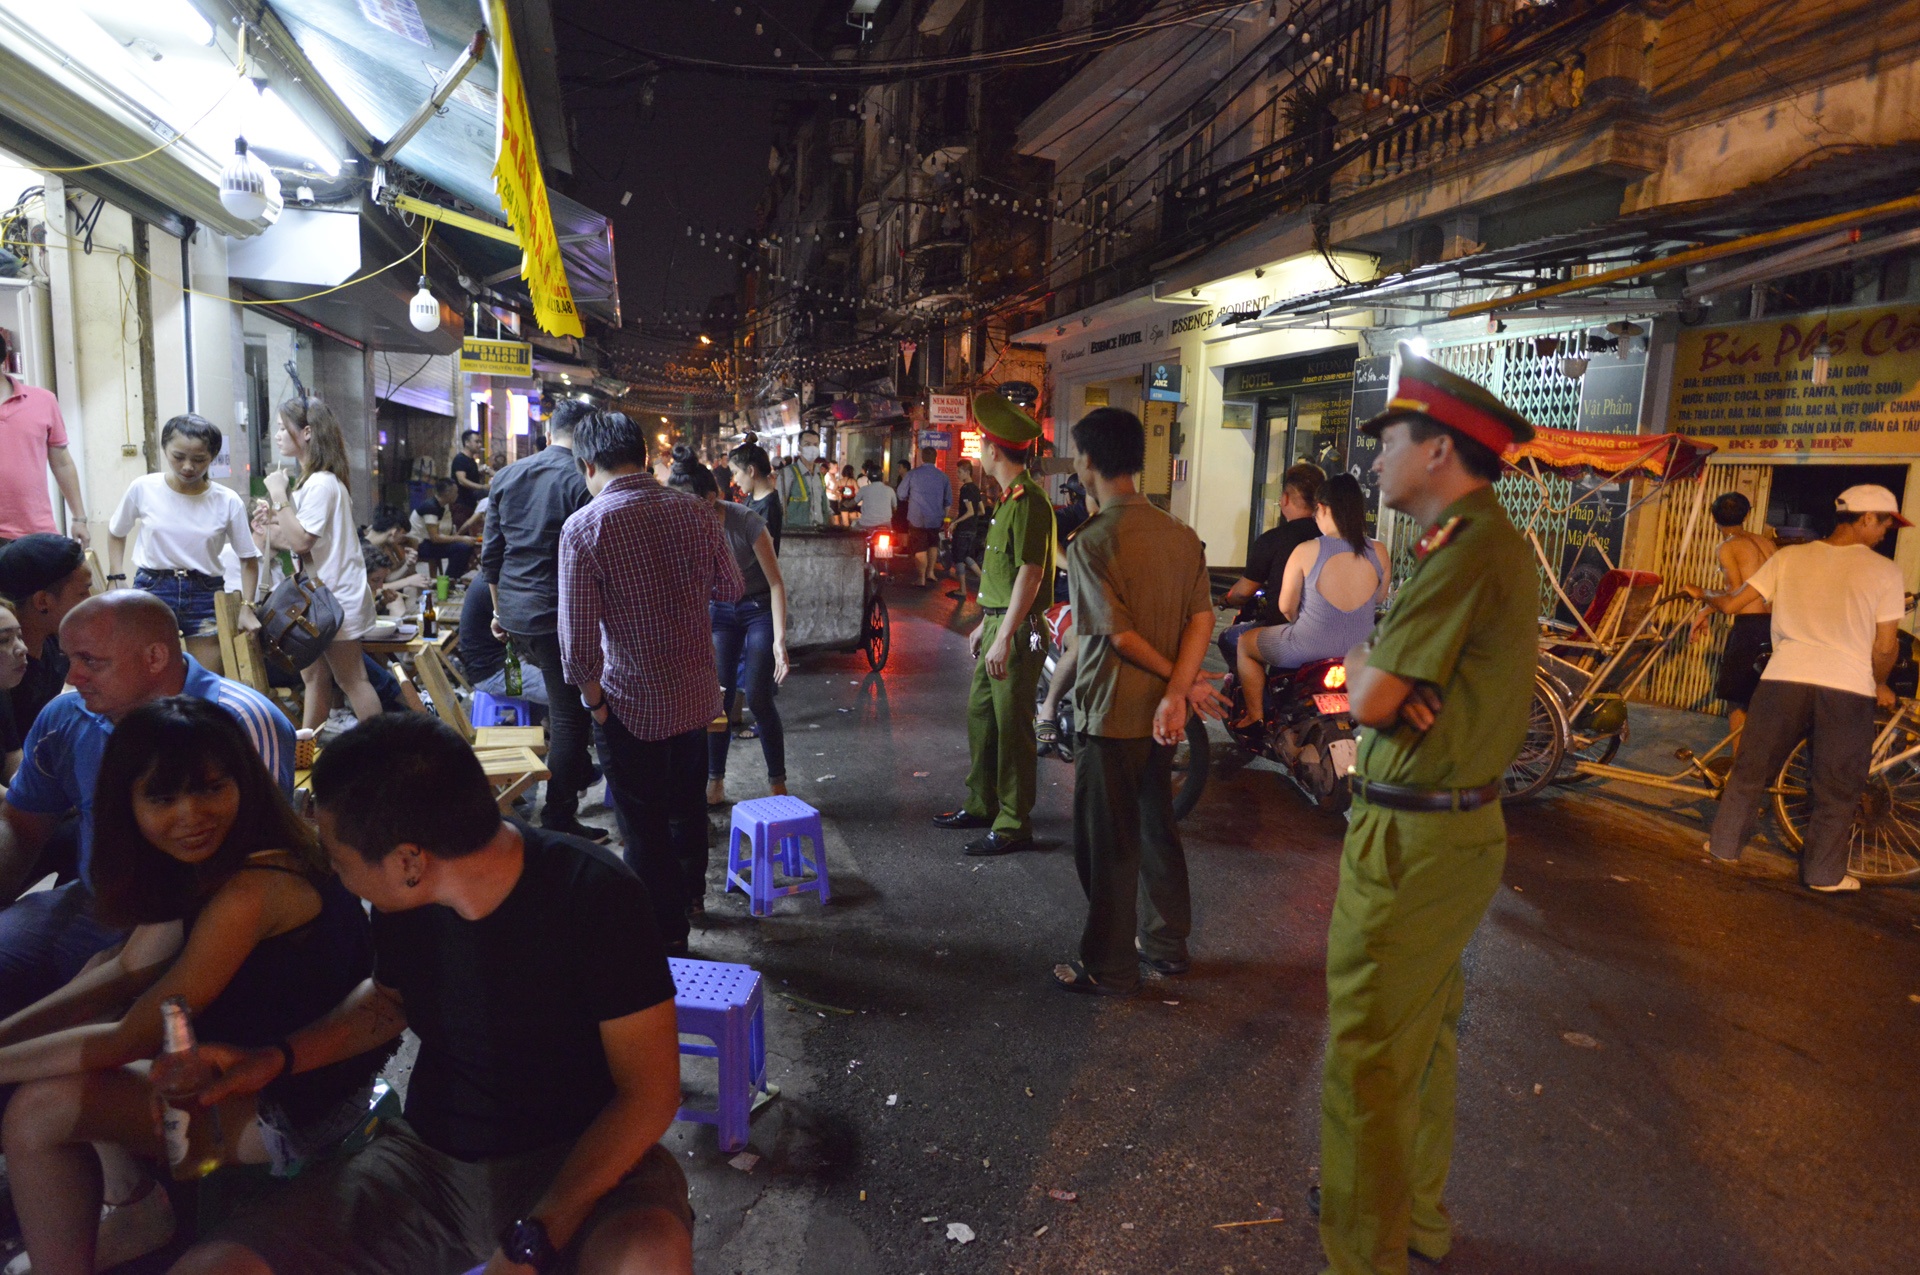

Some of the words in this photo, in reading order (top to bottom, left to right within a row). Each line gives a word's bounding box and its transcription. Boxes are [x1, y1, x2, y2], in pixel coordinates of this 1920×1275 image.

[1171, 310, 1214, 334] ESSENCE
[463, 344, 518, 356] WESTERN
[480, 352, 518, 364] UNION
[1699, 332, 1762, 372] Bia
[1241, 372, 1270, 389] HOTEL
[1584, 400, 1600, 419] Vật
[1602, 394, 1632, 415] Phẩm
[1569, 504, 1594, 526] Pháp
